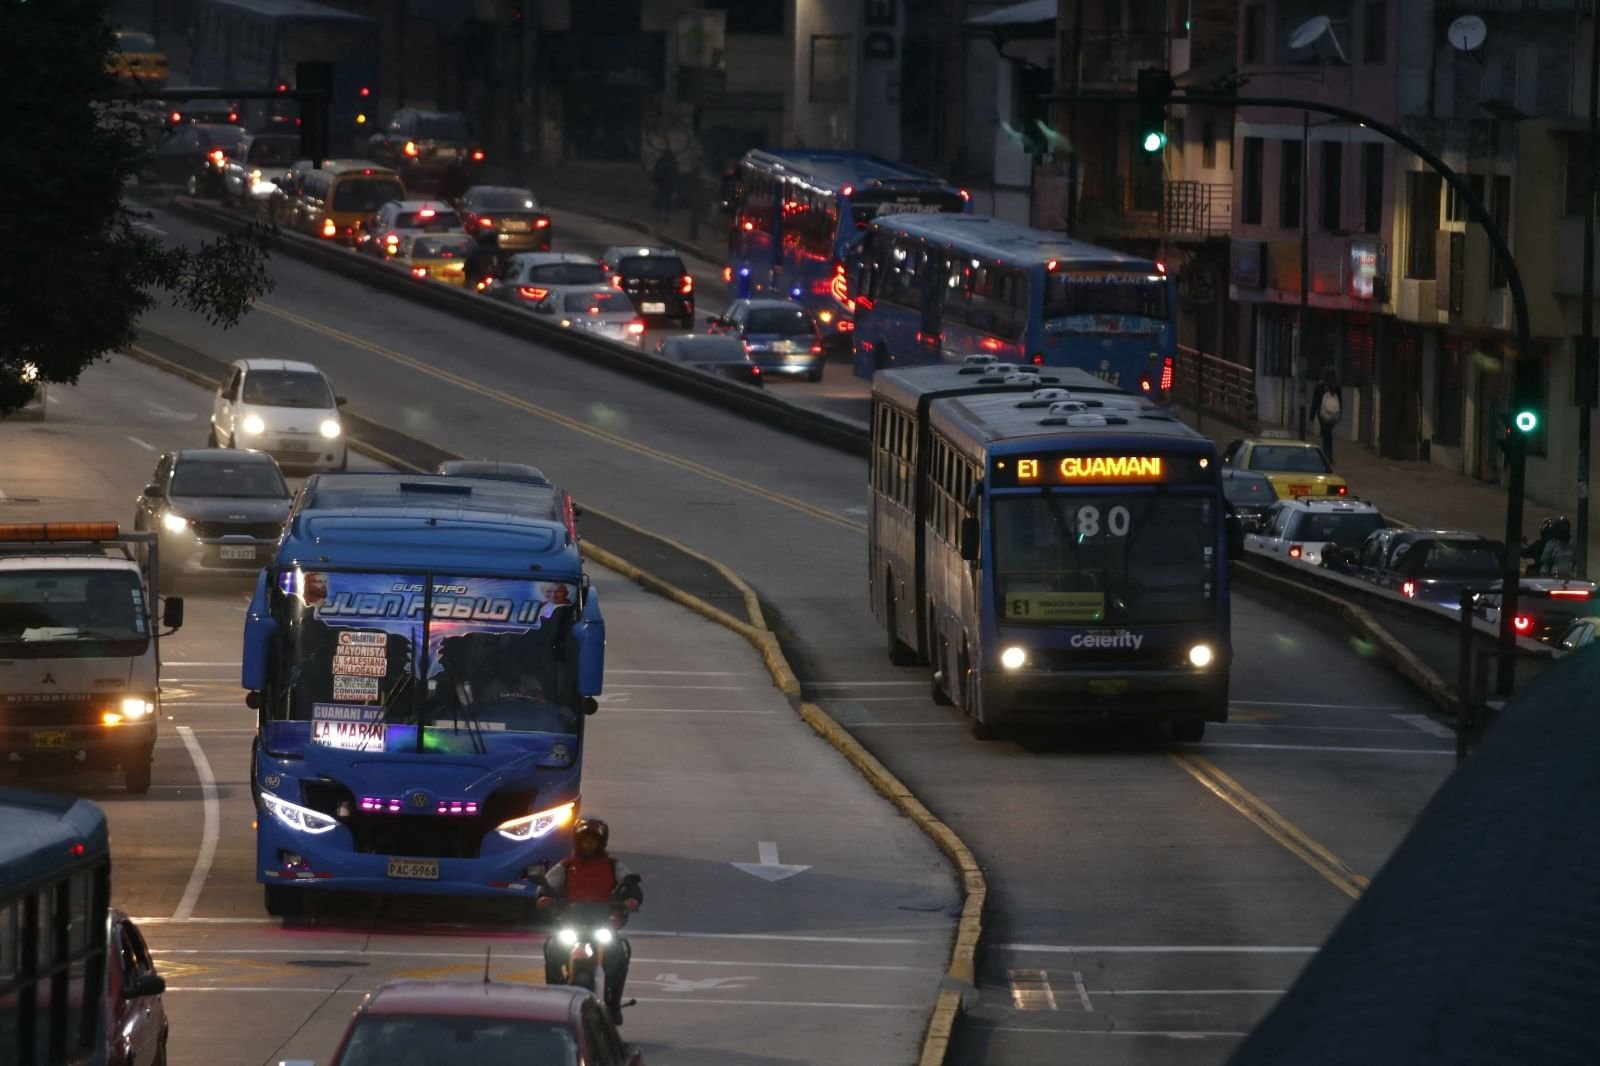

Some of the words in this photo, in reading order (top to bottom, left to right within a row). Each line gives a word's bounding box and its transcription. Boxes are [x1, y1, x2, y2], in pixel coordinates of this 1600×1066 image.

[1017, 458, 1039, 478] E1
[1060, 457, 1161, 478] GUAMANI
[1077, 505, 1131, 536] 80
[391, 583, 424, 592] BUS
[432, 584, 467, 594] TIPO
[1012, 599, 1030, 615] E1
[337, 647, 385, 657] MAYORISTA
[334, 656, 341, 665] U.
[344, 657, 385, 667] SALESIANA
[333, 665, 385, 675] CHILLOGALLO
[314, 706, 361, 720] GUAMANI
[313, 721, 330, 738] LA
[389, 864, 437, 876] PAC-5968
